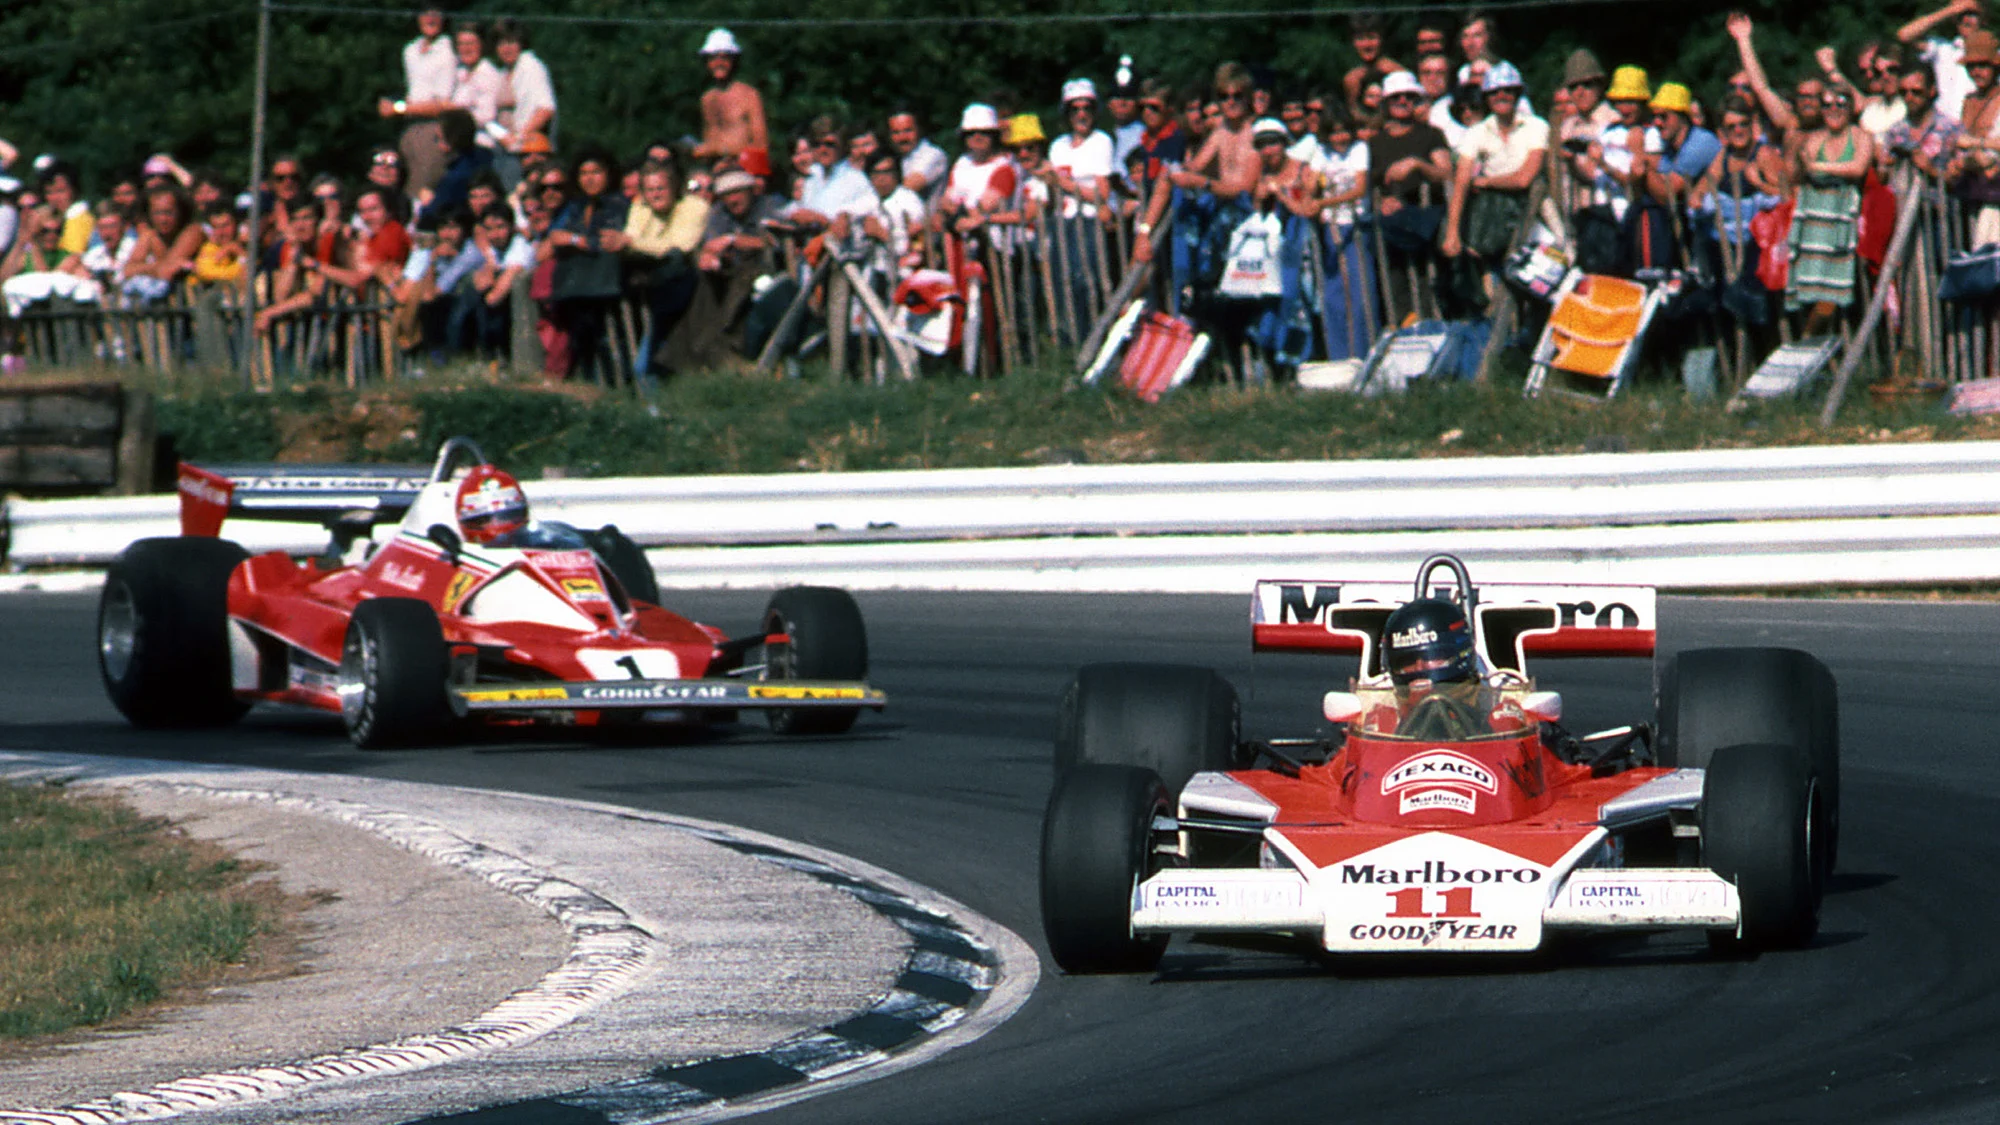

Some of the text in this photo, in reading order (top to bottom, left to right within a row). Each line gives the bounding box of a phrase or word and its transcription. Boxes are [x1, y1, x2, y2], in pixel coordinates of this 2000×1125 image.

[614, 655, 645, 681] 1
[1390, 761, 1490, 784] TEXACO
[1341, 860, 1542, 884] Marlboro
[1157, 886, 1217, 897] CAPITAL
[1385, 886, 1482, 919] 11
[1582, 886, 1642, 897] CAPITAL
